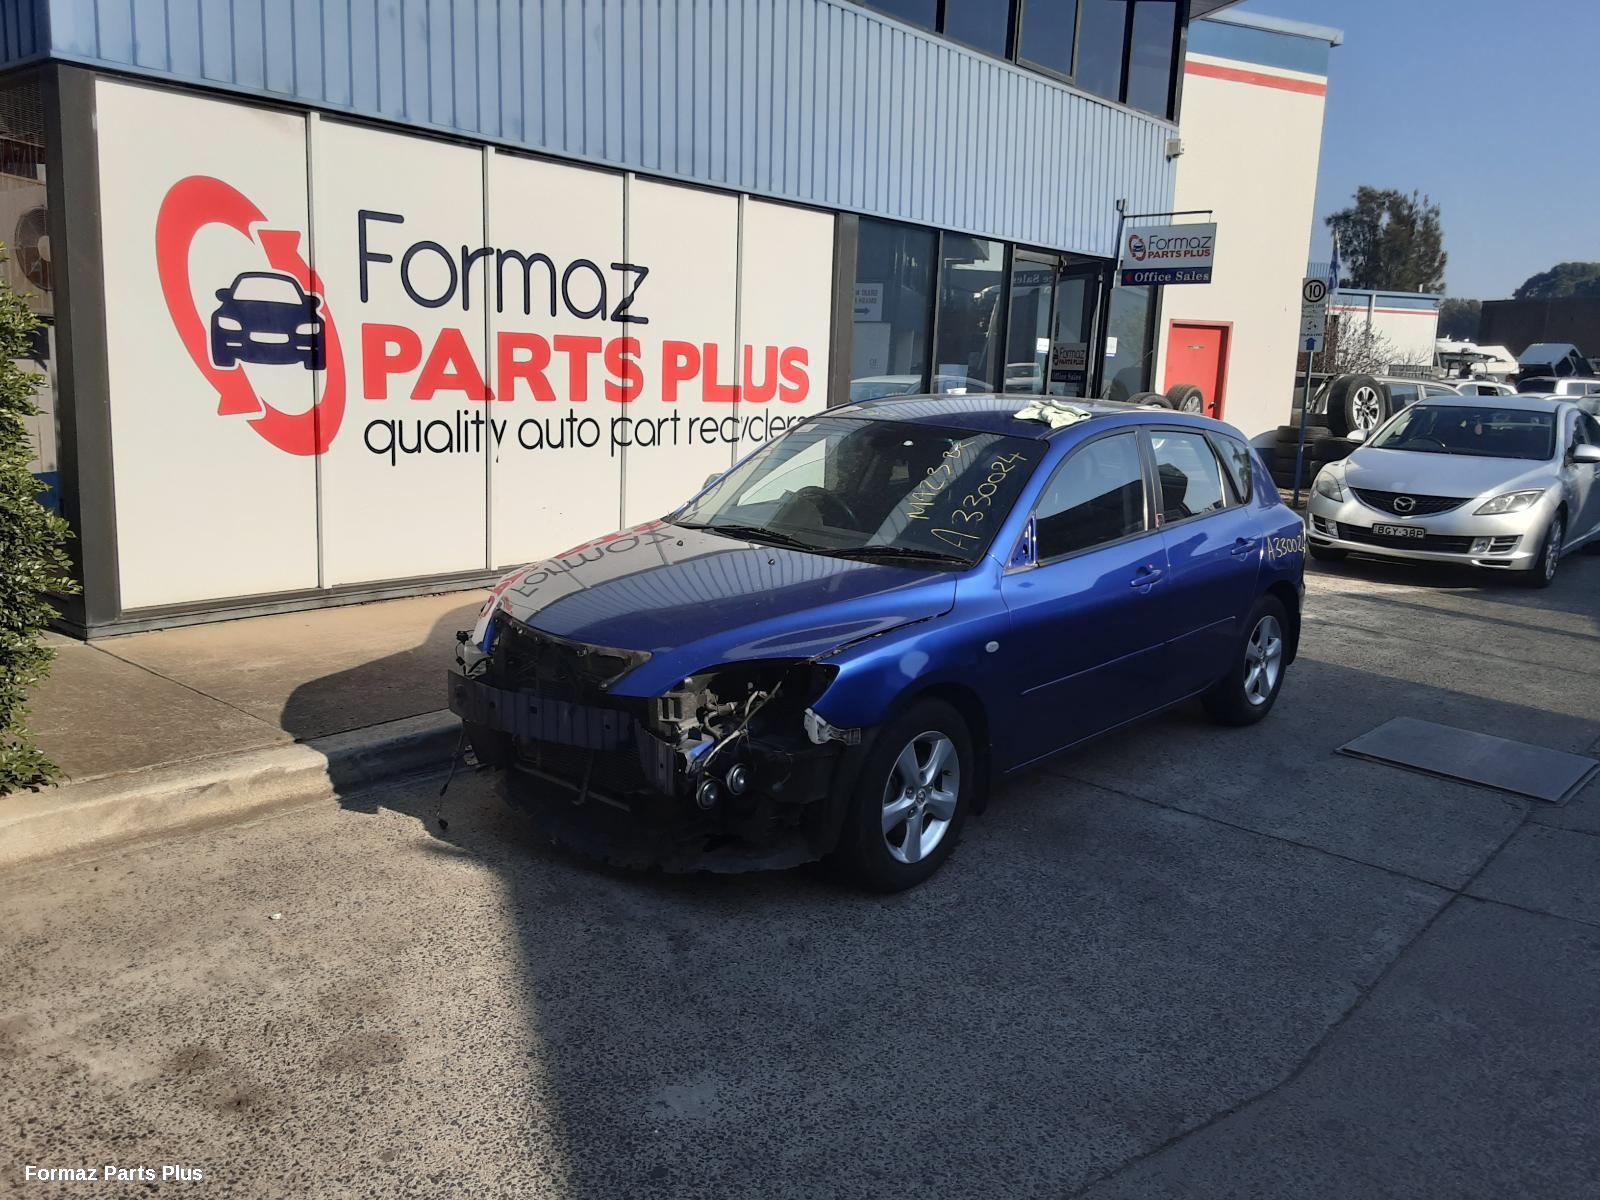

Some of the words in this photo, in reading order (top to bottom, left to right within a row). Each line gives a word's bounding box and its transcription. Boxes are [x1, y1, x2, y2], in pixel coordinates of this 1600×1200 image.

[1147, 250, 1181, 259] PARTS
[1183, 248, 1211, 258] PLUS
[1148, 235, 1212, 250] Formaz
[358, 209, 649, 325] Formaz
[1134, 272, 1172, 283] Office
[1175, 270, 1209, 282] Sales
[1308, 284, 1322, 299] 10
[361, 322, 645, 403] PARTS
[661, 339, 810, 404] PLUS
[363, 409, 508, 466] quality
[517, 408, 601, 450] auto
[610, 408, 681, 458] part
[930, 452, 1028, 551] A330024
